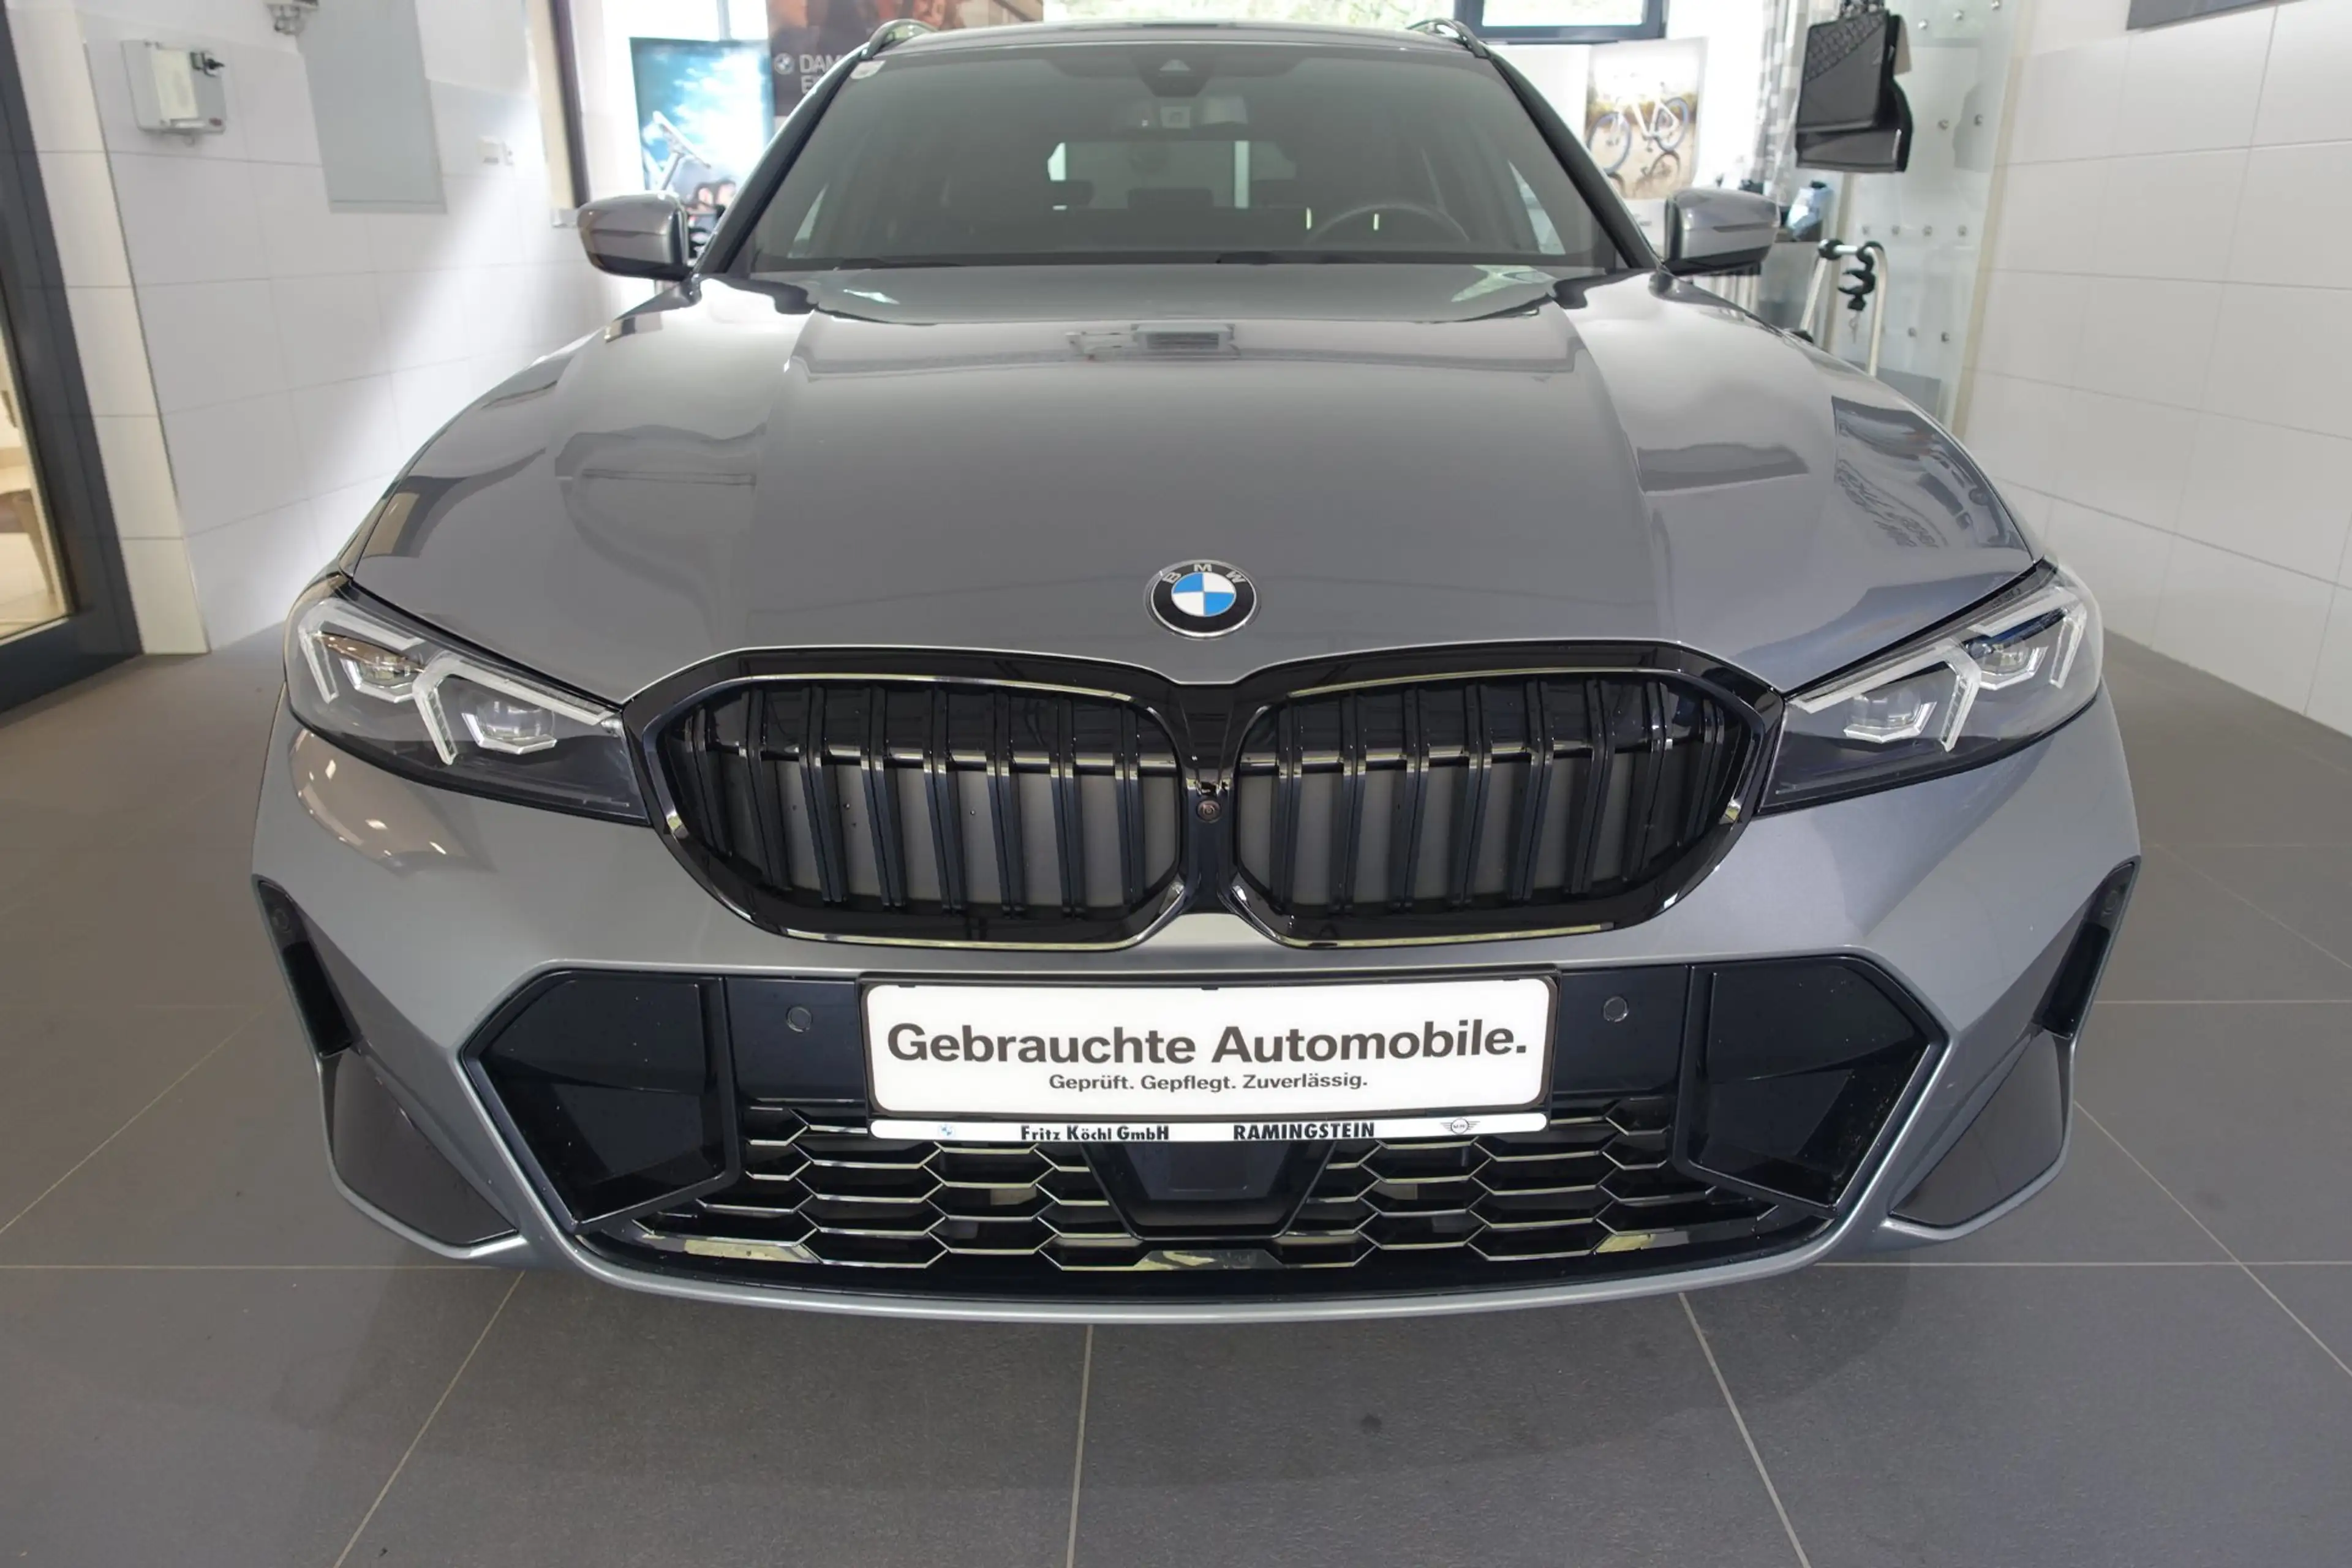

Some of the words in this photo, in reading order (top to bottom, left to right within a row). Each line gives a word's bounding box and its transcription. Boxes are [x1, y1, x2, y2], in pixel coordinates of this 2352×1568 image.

[1163, 564, 1246, 583] BMW
[888, 1023, 1196, 1063] Gebrauchte
[1211, 1019, 1528, 1063] Automobile.
[1049, 1074, 1134, 1093] Geprüft.
[1140, 1074, 1237, 1093] Gepflegt.
[1243, 1072, 1368, 1090] Zuverlässig.
[1021, 1125, 1061, 1140] Fritz
[1066, 1125, 1112, 1140] Köchl
[1117, 1125, 1169, 1140] GmbH
[1233, 1122, 1374, 1140] RAMINGSTEIN
